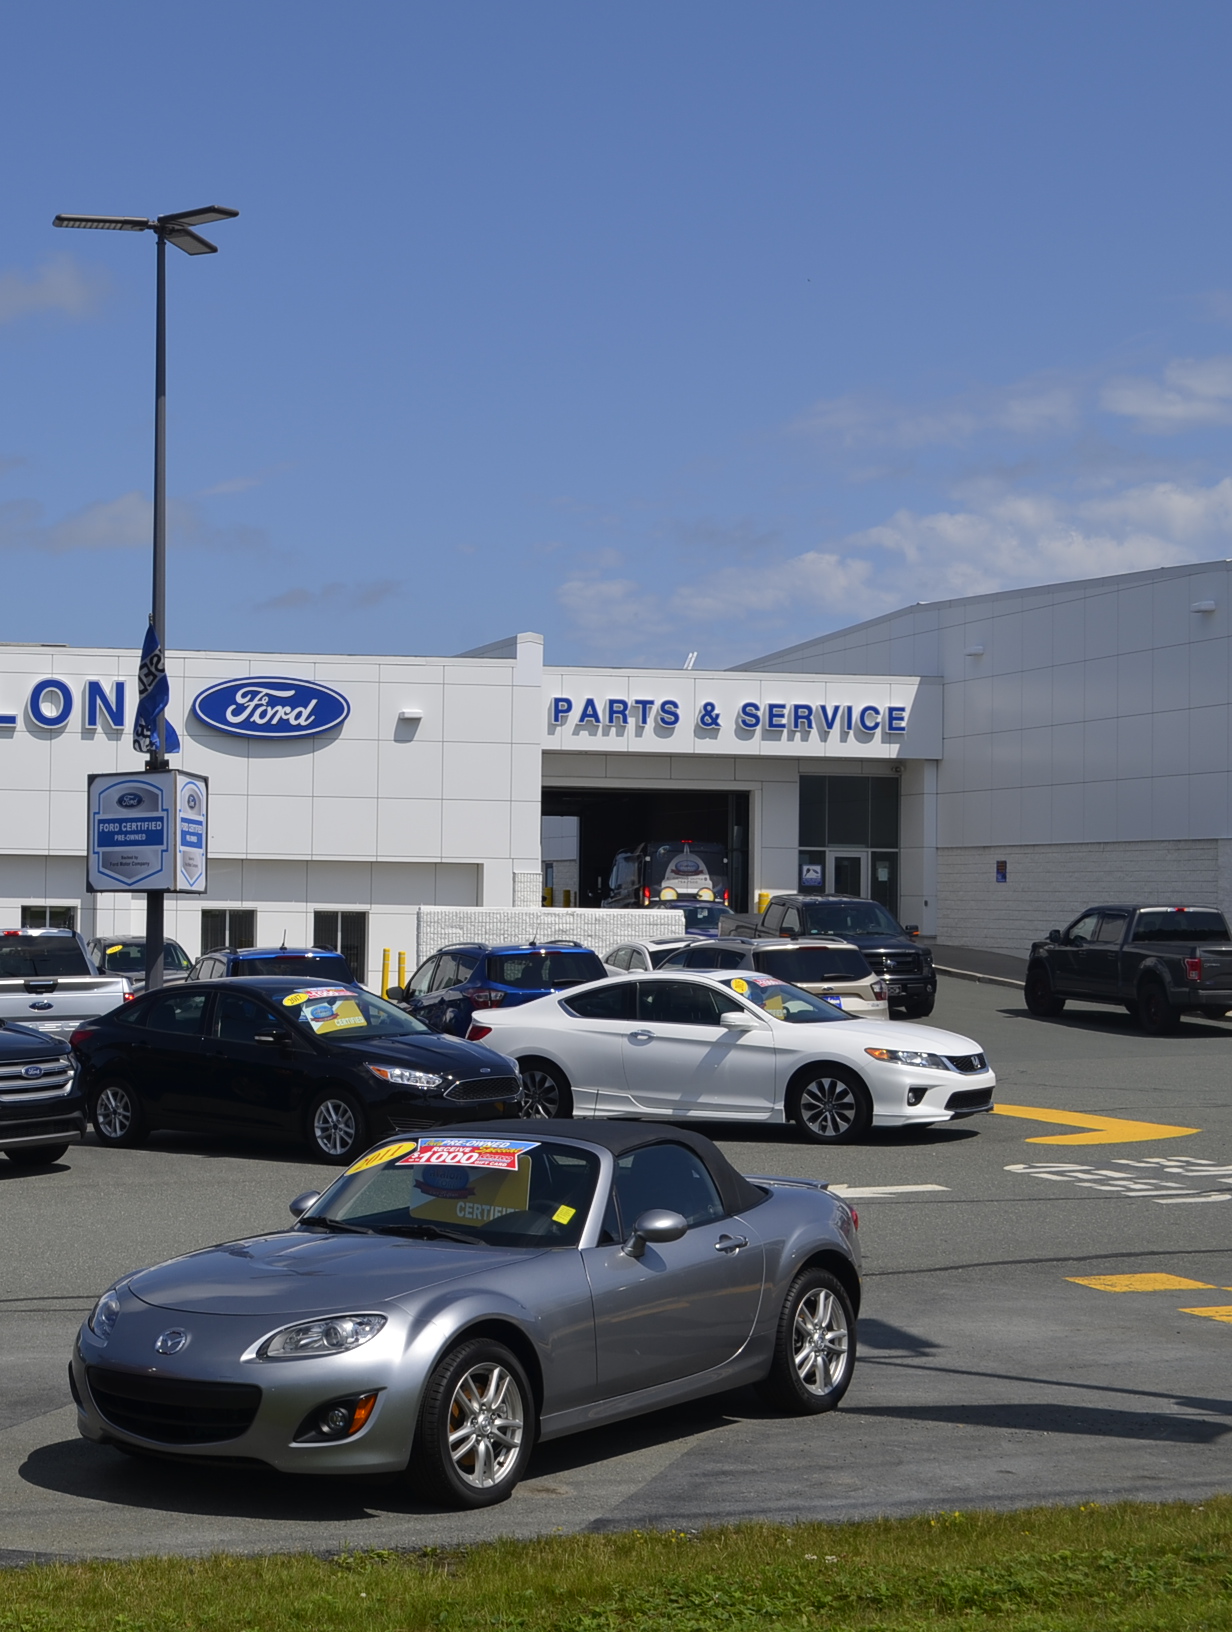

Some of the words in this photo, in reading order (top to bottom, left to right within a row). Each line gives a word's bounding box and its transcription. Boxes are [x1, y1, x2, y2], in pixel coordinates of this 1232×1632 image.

[226, 686, 318, 726] Ford
[552, 697, 681, 727] PARTS
[699, 701, 722, 729] &
[740, 701, 907, 734] SERVICE
[122, 795, 139, 806] Ford
[99, 823, 120, 832] FORD
[121, 821, 163, 831] CERTIFIED
[114, 833, 147, 841] PRE-OWNED
[440, 1140, 510, 1148] PRE-OWNED
[411, 1152, 479, 1164] $1000
[456, 1201, 520, 1221] CERTIF
